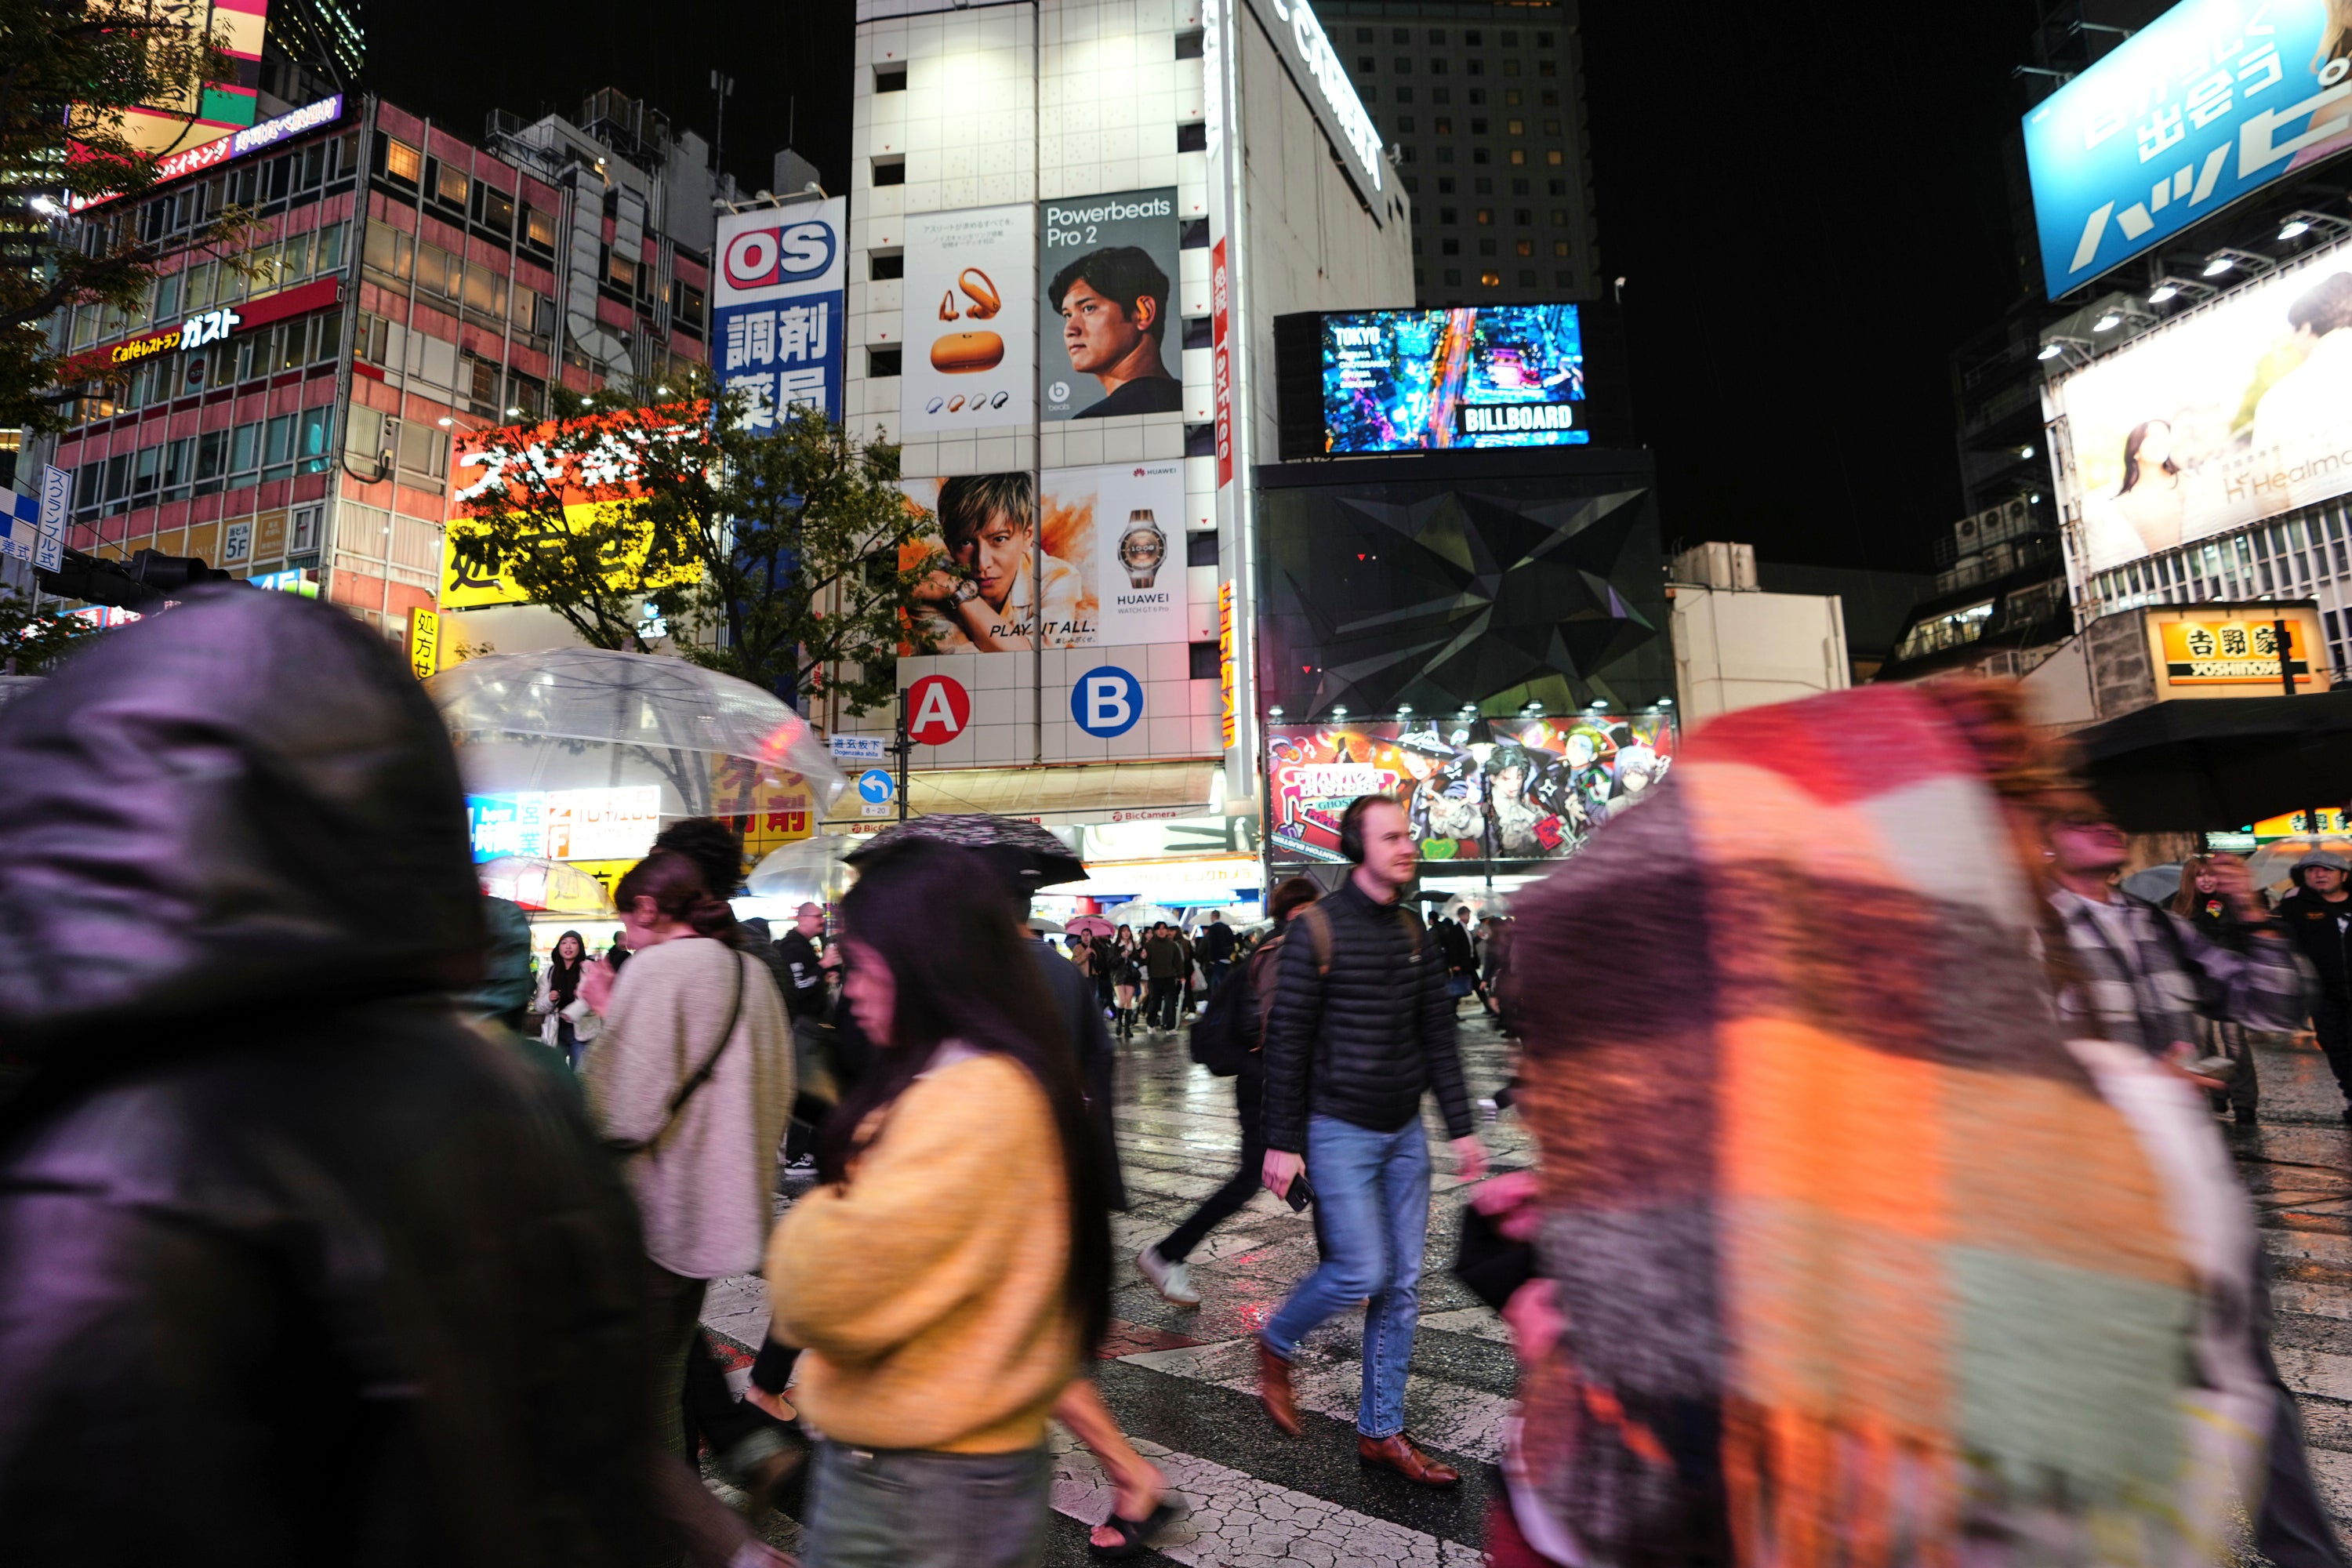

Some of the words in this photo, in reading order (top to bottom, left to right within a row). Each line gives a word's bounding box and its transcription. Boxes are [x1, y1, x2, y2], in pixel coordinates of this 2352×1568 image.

[1294, 8, 1381, 191] CAMERA
[2136, 42, 2283, 165] 出会う
[1047, 198, 1171, 227] Powerbeats
[1047, 227, 1081, 248] Pro
[1086, 225, 1098, 244] 2
[728, 223, 828, 281] OS
[180, 308, 240, 350] ガスト
[726, 302, 829, 370] 調剤
[1334, 325, 1381, 346] TOKYO
[723, 366, 827, 431] 薬局
[1216, 329, 1230, 461] TaxFree
[1465, 405, 1573, 433] BILLBOARD
[226, 538, 247, 559] 5F
[1117, 593, 1169, 605] HUAWEI
[989, 623, 1032, 637] PLAY
[1041, 622, 1058, 636] IT
[1060, 620, 1095, 634] ALL.
[1054, 636, 1096, 644] 楽しみ尽くせ。
[2189, 627, 2280, 655] 吉野家
[1218, 579, 1236, 750] ビックカメラ
[911, 684, 958, 733] A
[1087, 677, 1131, 728] B
[834, 738, 880, 750] 道玄坂下
[834, 748, 864, 757] Dogenzaka
[519, 796, 541, 857] 営業
[1125, 811, 1176, 820] BicCamera
